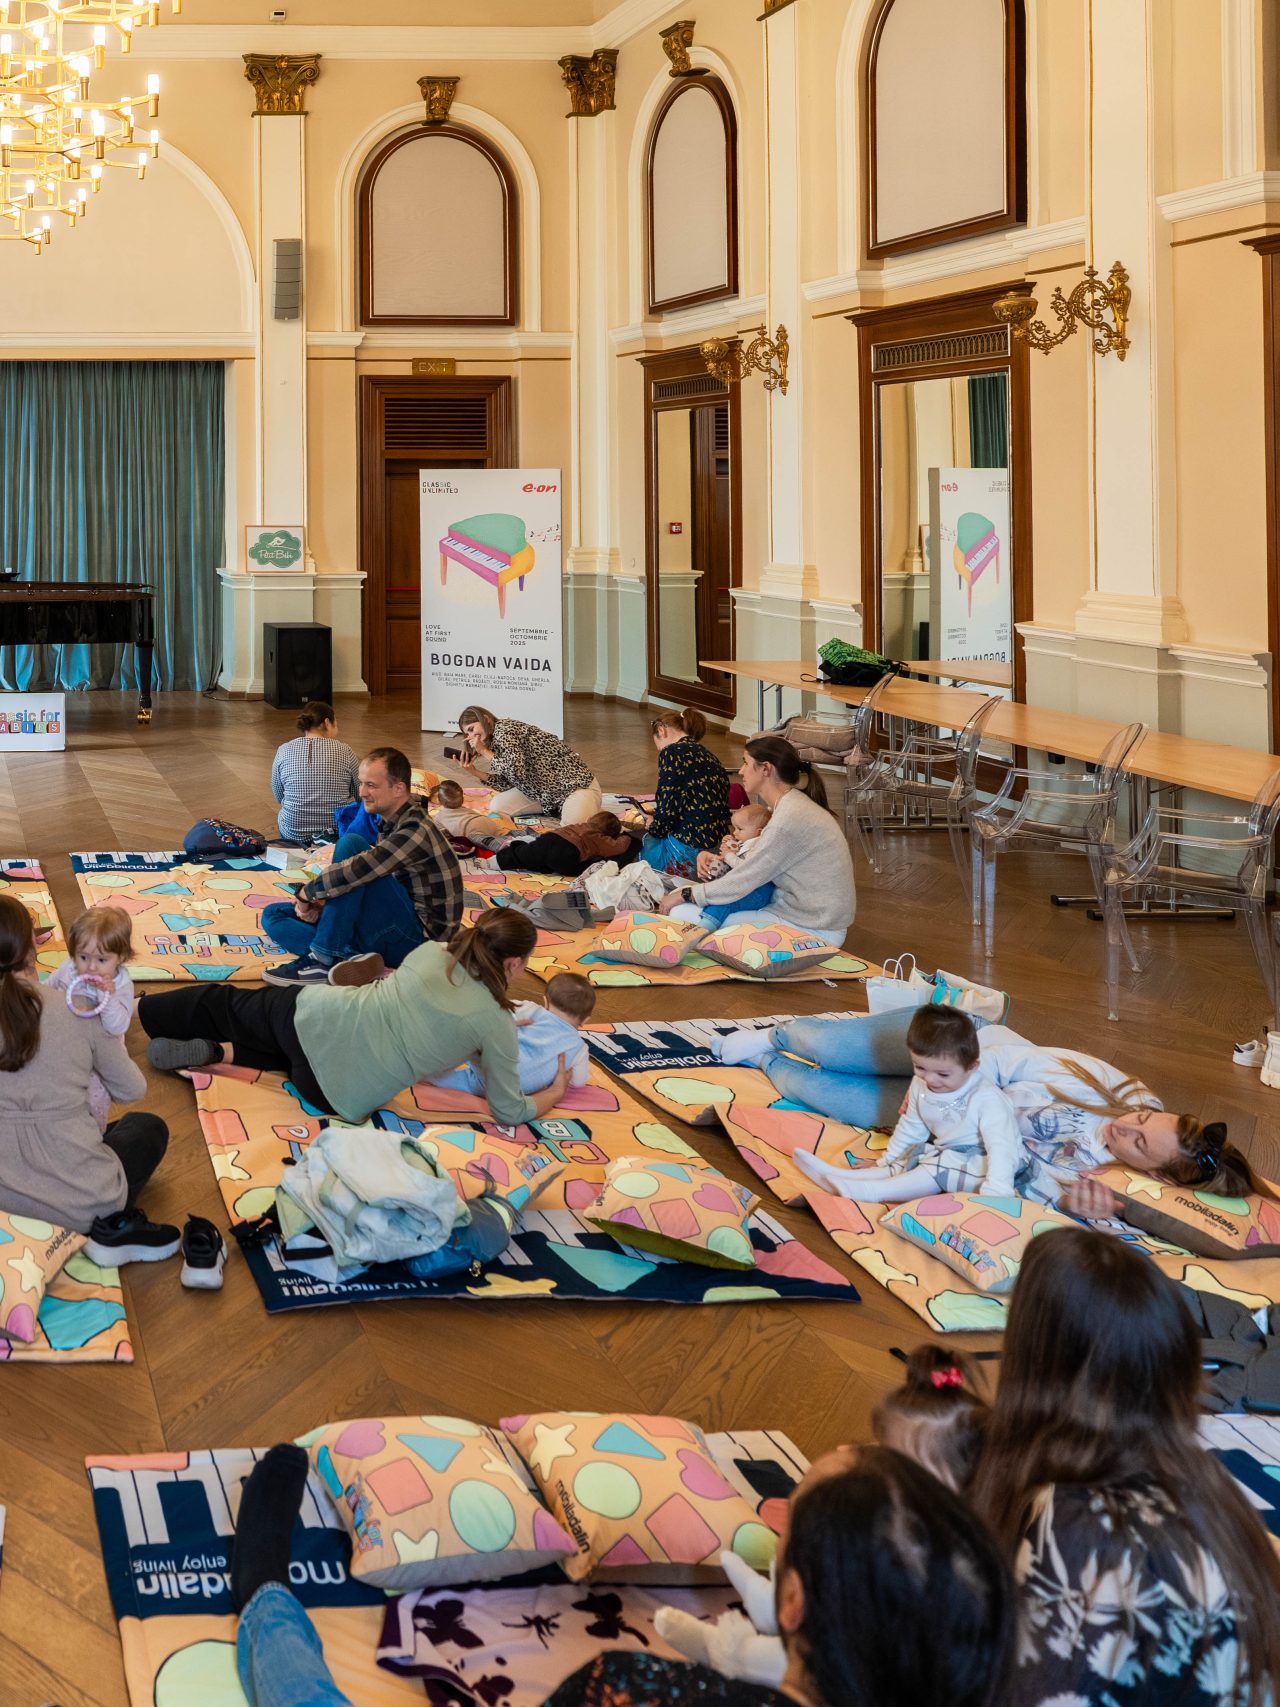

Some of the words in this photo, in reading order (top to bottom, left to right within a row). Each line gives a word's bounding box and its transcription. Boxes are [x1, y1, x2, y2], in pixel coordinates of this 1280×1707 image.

[509, 627, 549, 635] SEPTEMBRIE
[430, 652, 497, 669] BOGDAN
[503, 656, 552, 672] VAIDA
[40, 709, 61, 722] for
[1174, 1195, 1239, 1236] mobiladalin
[556, 1479, 591, 1554] mobiladalin
[132, 1558, 177, 1574] living
[182, 1554, 227, 1570] enjoy
